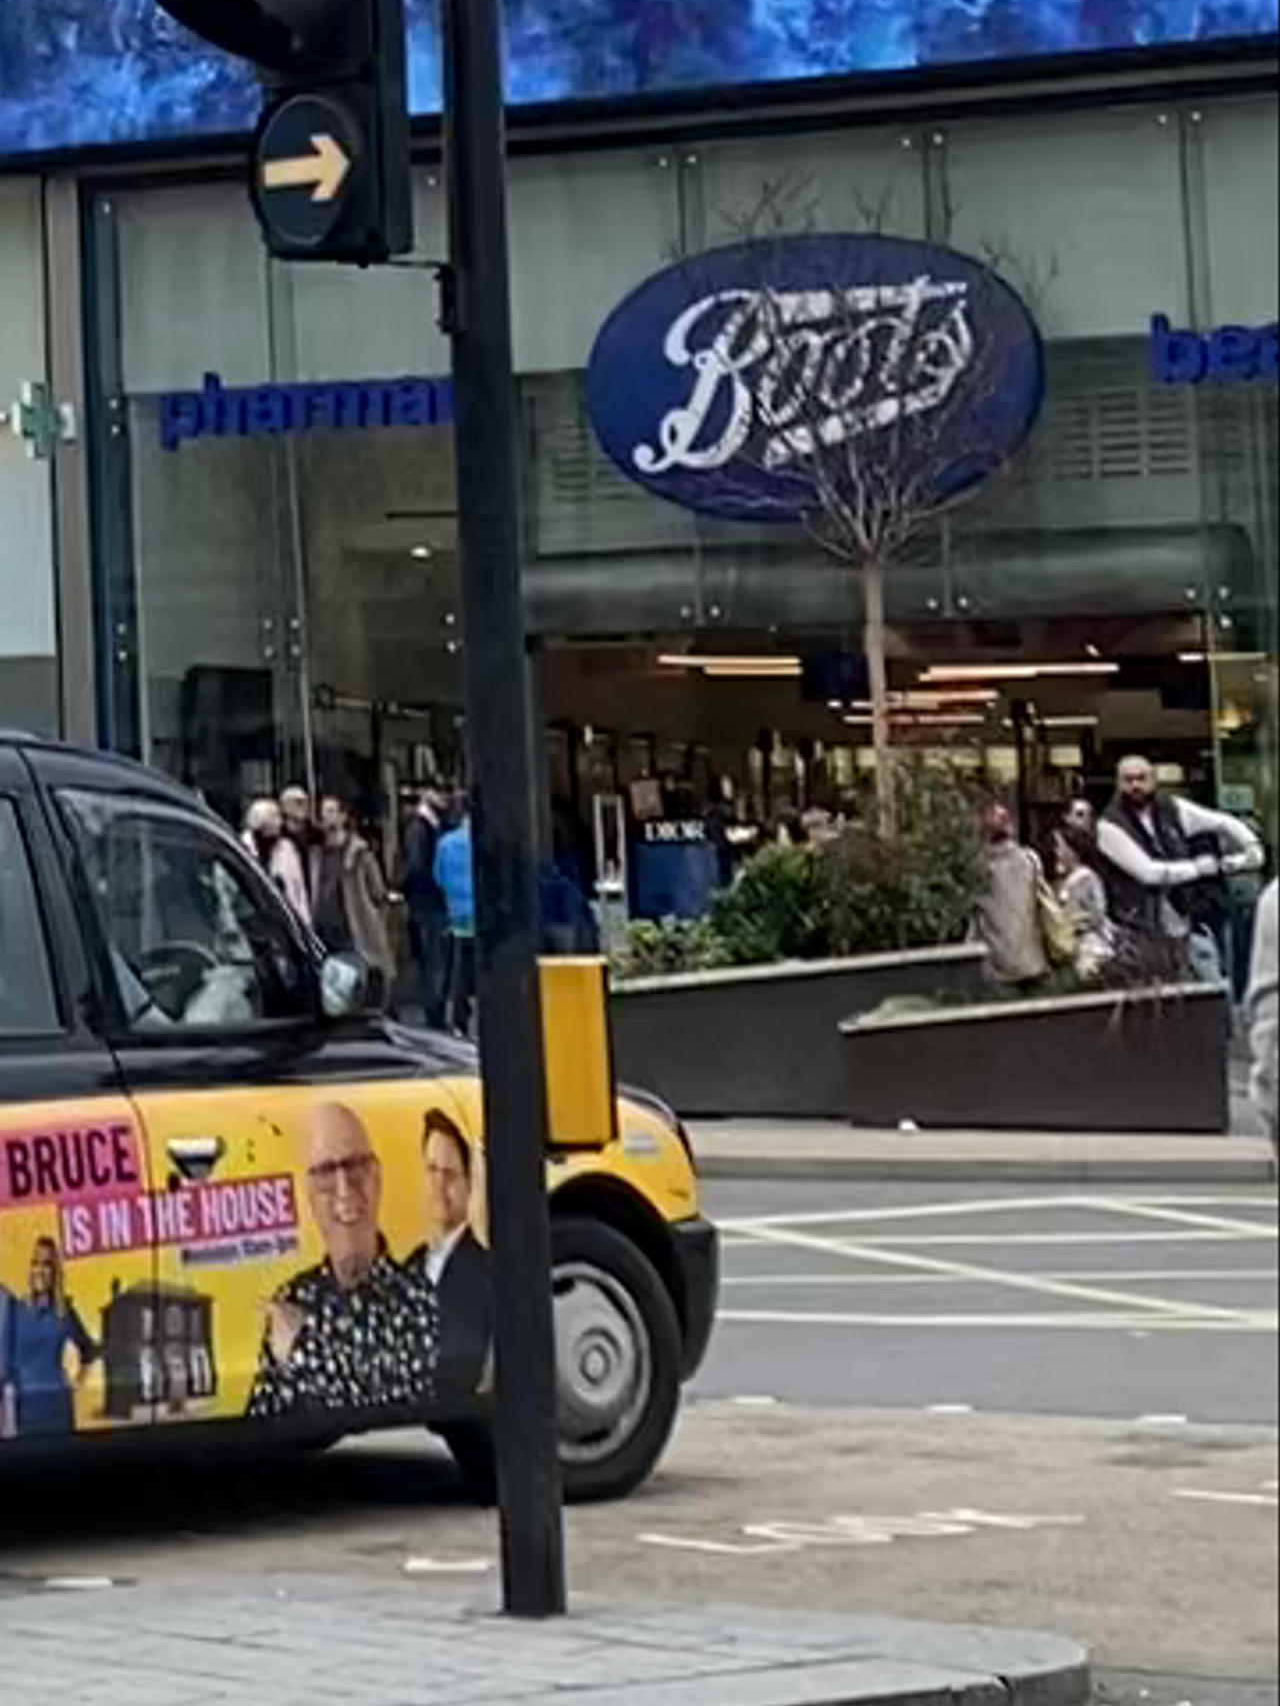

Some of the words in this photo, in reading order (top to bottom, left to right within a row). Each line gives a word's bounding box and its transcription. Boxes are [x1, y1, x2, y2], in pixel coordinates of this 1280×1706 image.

[633, 275, 973, 474] Boots
[6, 1125, 138, 1199] BRUCE
[62, 1206, 93, 1254] IS
[97, 1198, 132, 1249] IN
[137, 1188, 196, 1244] THE
[199, 1180, 294, 1237] HOUSE
